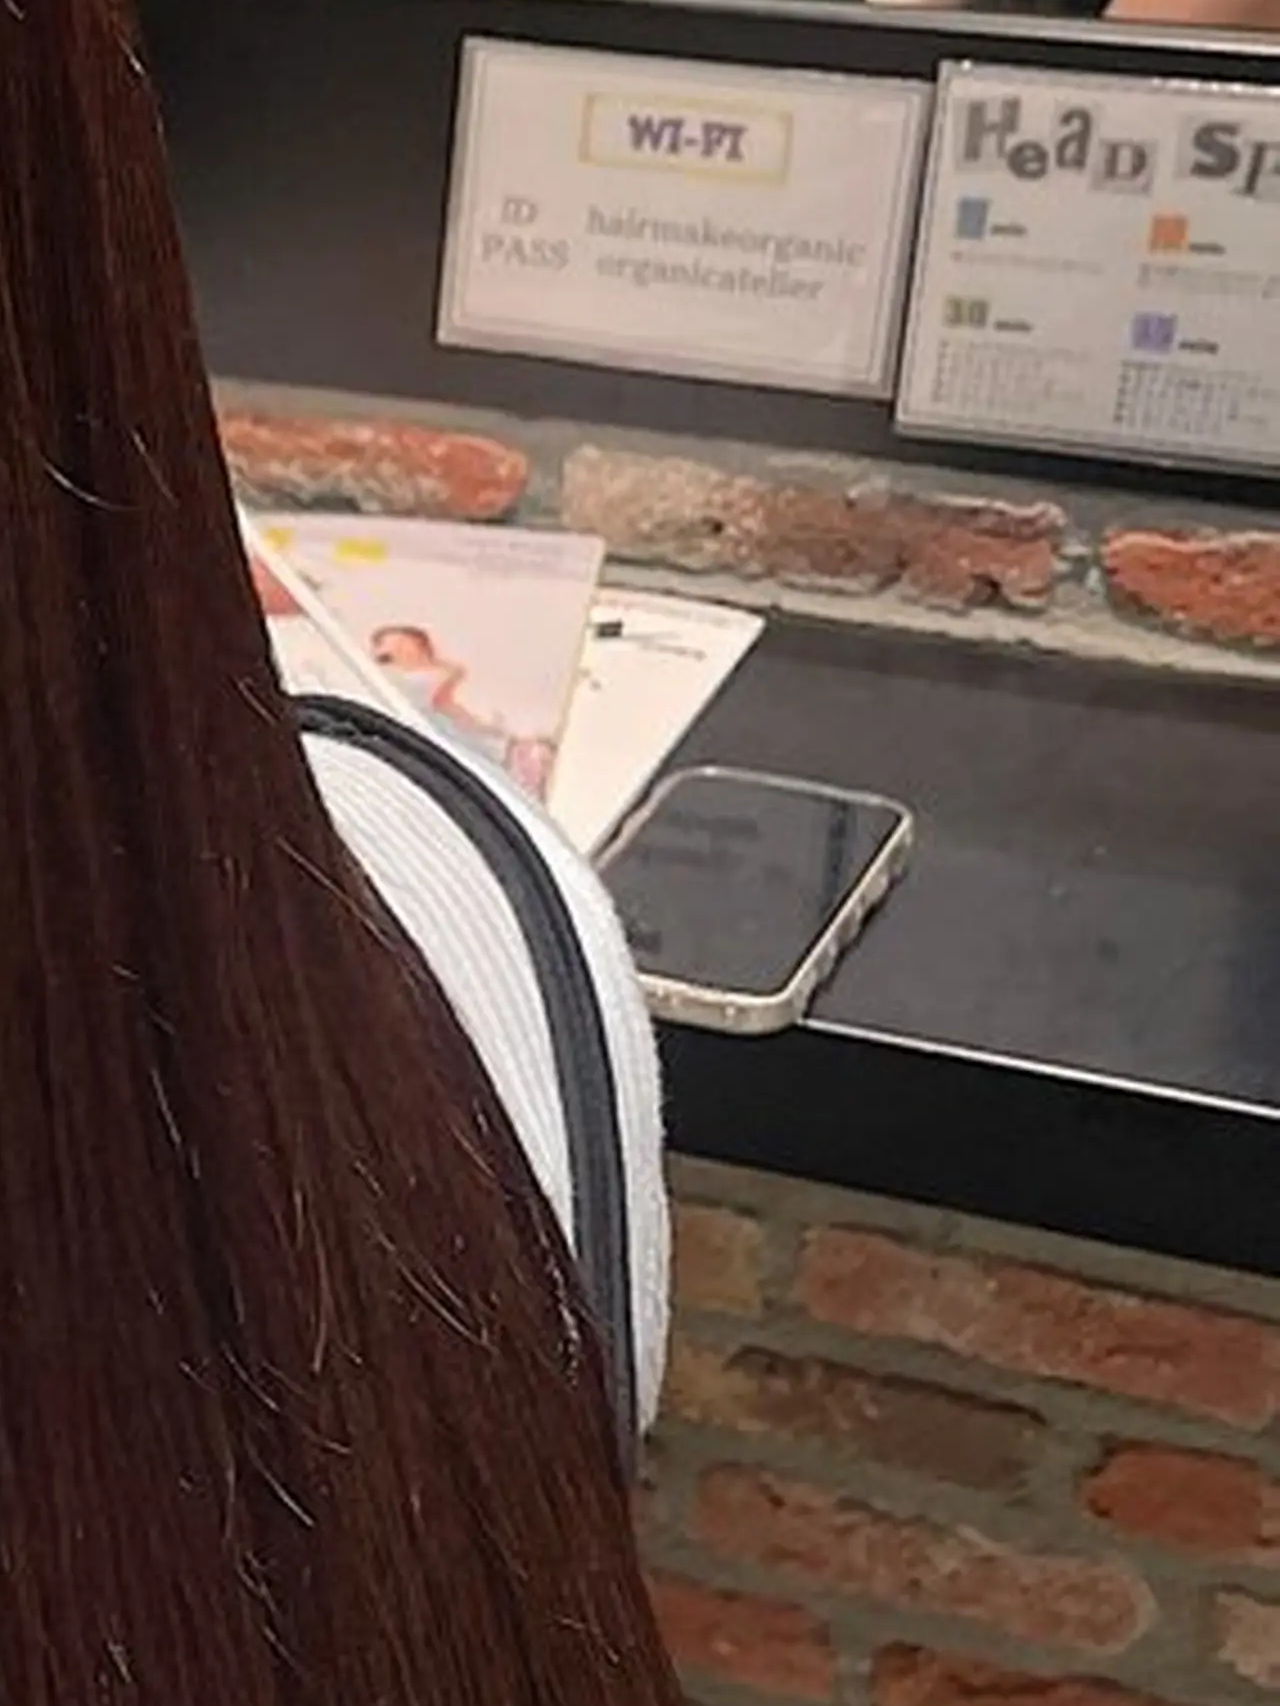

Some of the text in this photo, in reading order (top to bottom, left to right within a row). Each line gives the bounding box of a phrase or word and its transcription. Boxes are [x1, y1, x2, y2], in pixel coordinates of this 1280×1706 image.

[500, 195, 868, 266] ID hairmakeorganic
[480, 233, 825, 299] PASS organicatelier
